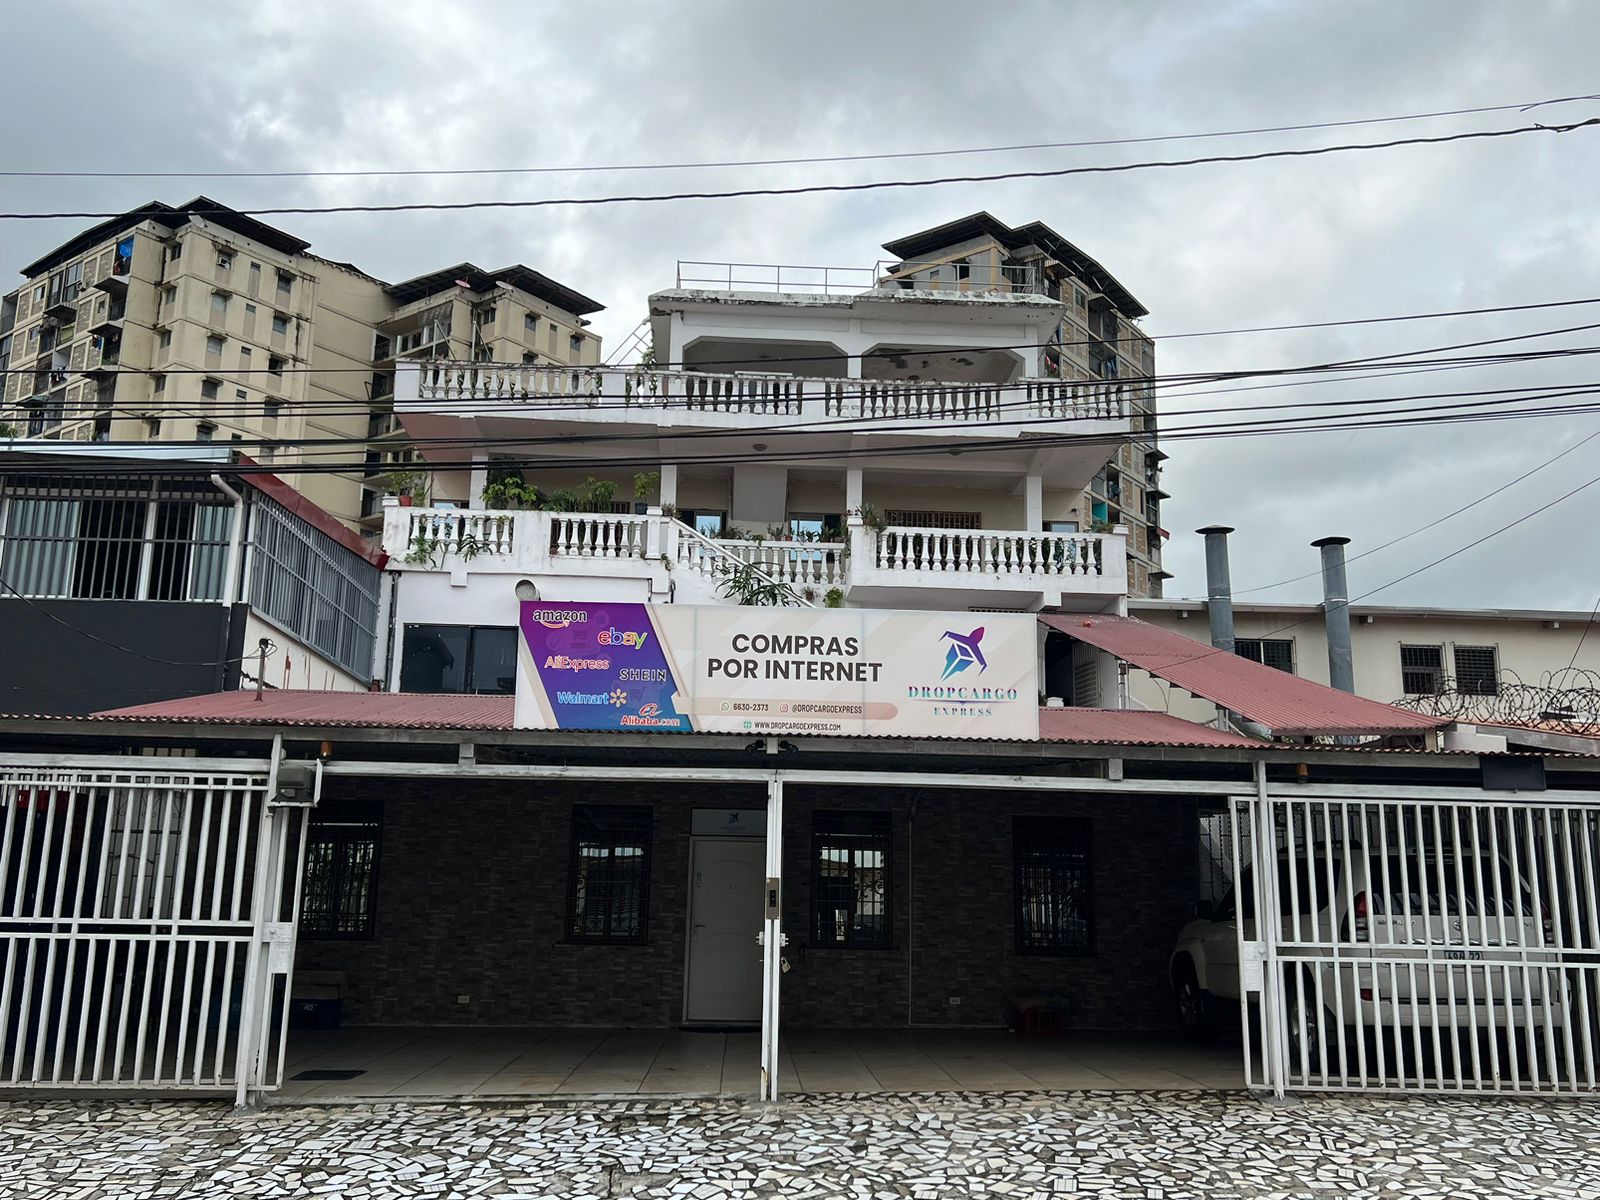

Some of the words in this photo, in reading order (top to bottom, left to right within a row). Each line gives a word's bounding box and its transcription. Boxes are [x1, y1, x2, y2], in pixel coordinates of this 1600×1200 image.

[533, 610, 587, 623] amazon
[598, 627, 647, 649] ebay
[731, 633, 859, 656] COMPRAS
[544, 655, 609, 672] AliExpress
[619, 669, 667, 682] SHEIN
[707, 658, 758, 679] POR
[765, 660, 883, 683] INTERNET
[557, 691, 609, 705] Walmart
[908, 686, 1018, 700] DROPCARGO
[733, 703, 769, 712] 6630-2373
[792, 704, 863, 714] @DROPCARGOEXPRESS
[934, 707, 992, 717] EXPRESS
[620, 715, 680, 727] Alibaba.com
[754, 721, 841, 731] WWW.DROPCARGOEXPRESS.COM
